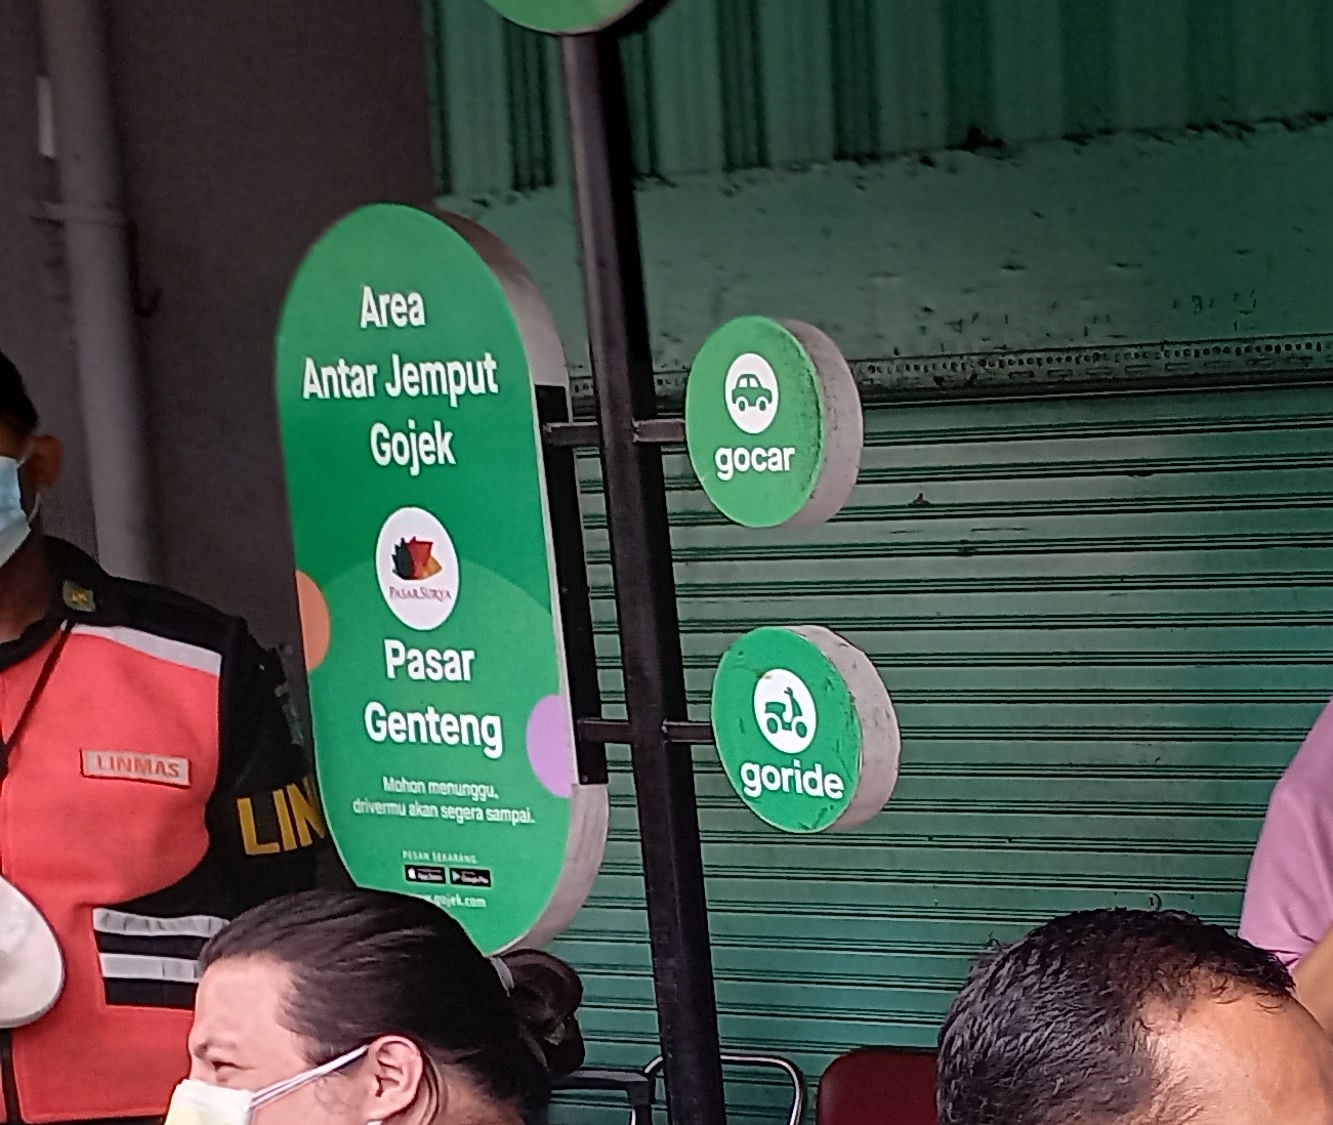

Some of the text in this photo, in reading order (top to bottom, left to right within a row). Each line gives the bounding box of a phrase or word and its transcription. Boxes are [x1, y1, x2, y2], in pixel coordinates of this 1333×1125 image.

[360, 286, 425, 328] Area
[302, 352, 499, 408] Antar Jemput
[370, 419, 456, 476] Gojek
[715, 445, 796, 480] gocar
[384, 639, 475, 681] Pasar
[364, 701, 503, 759] Genteng
[97, 755, 180, 777] LINMAS
[382, 776, 427, 794] Mohon
[741, 759, 845, 800] goride
[352, 798, 406, 816] drivermu
[408, 800, 439, 818] akan
[440, 804, 484, 824] segera
